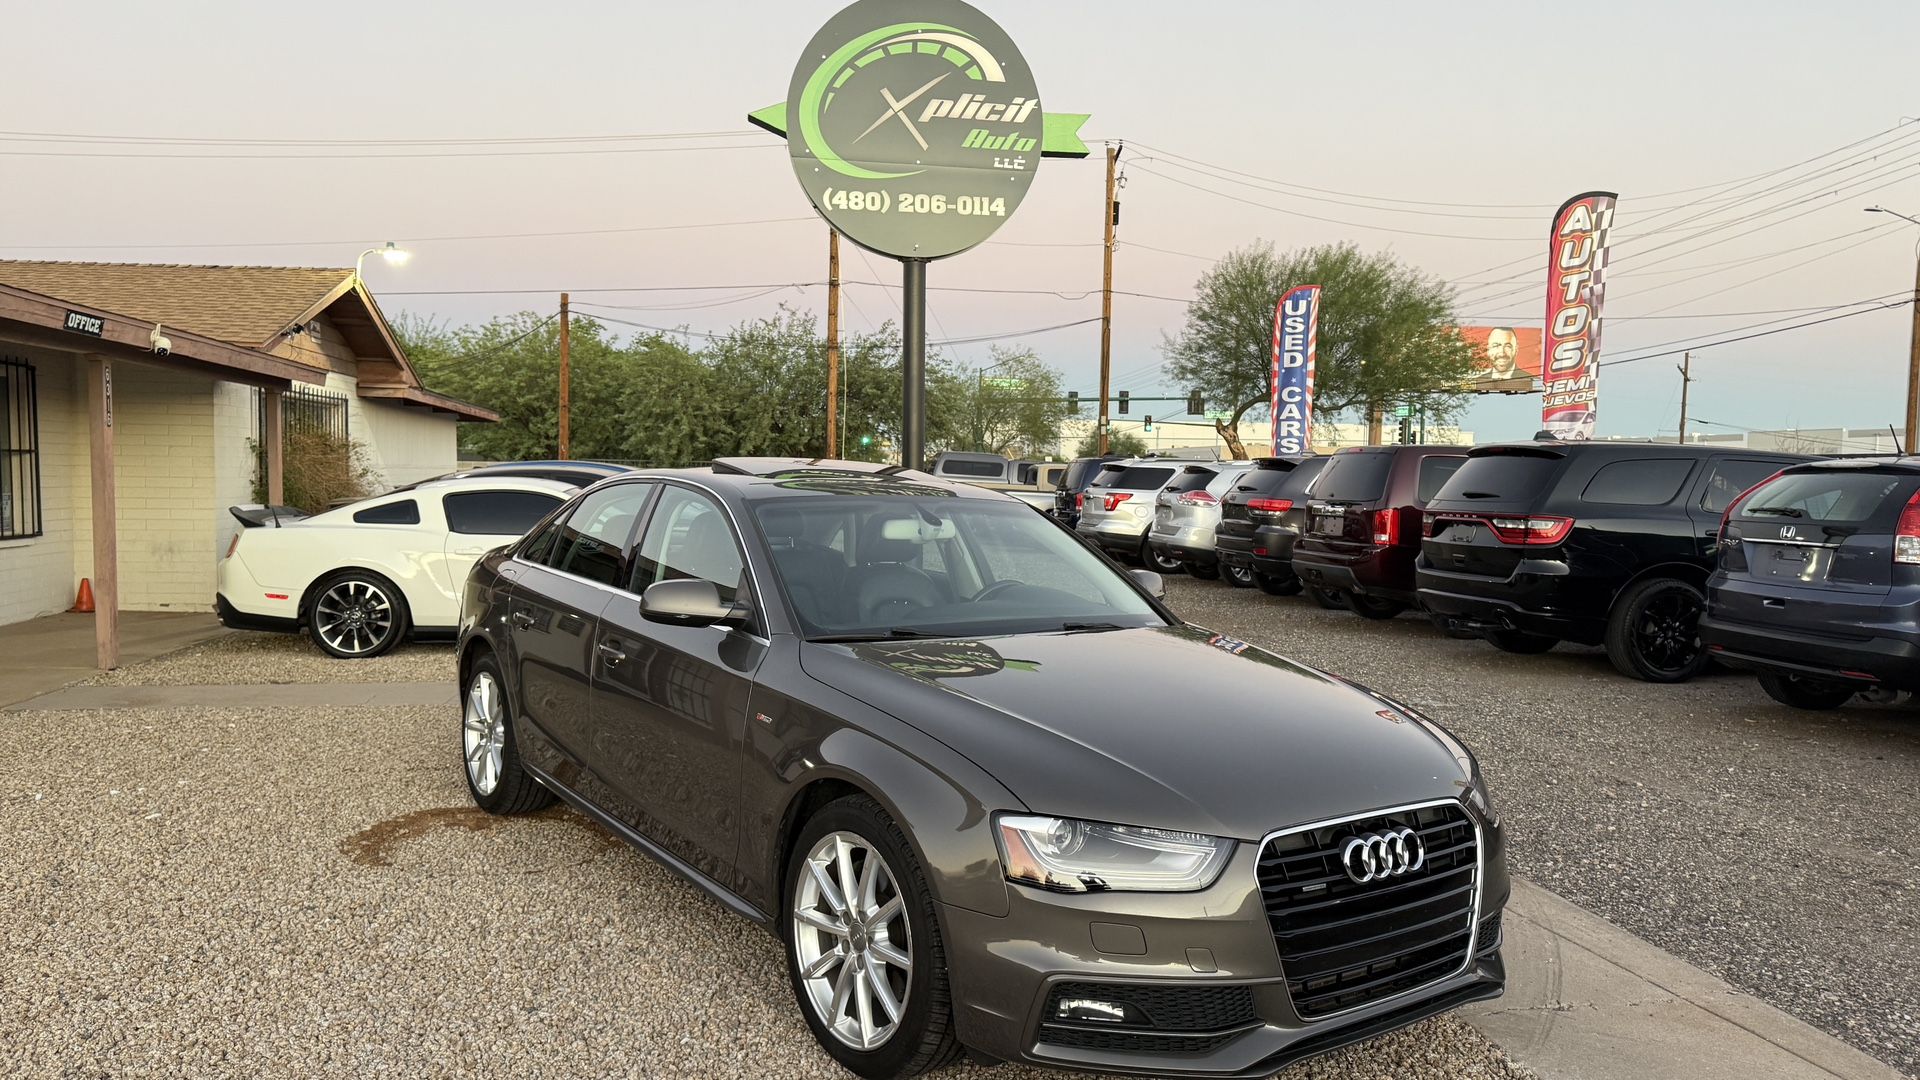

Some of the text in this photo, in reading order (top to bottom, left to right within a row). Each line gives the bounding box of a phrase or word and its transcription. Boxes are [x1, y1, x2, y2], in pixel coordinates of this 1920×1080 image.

[961, 128, 1037, 152] Auto
[993, 157, 1026, 170] LLC
[822, 187, 1006, 217] (480) 206-0114
[1550, 204, 1593, 373] AUTOS
[67, 312, 101, 333] OFFICE
[1279, 299, 1308, 454] USED CARS
[1545, 375, 1591, 396] SEMI
[1543, 390, 1595, 408] UEVOS
